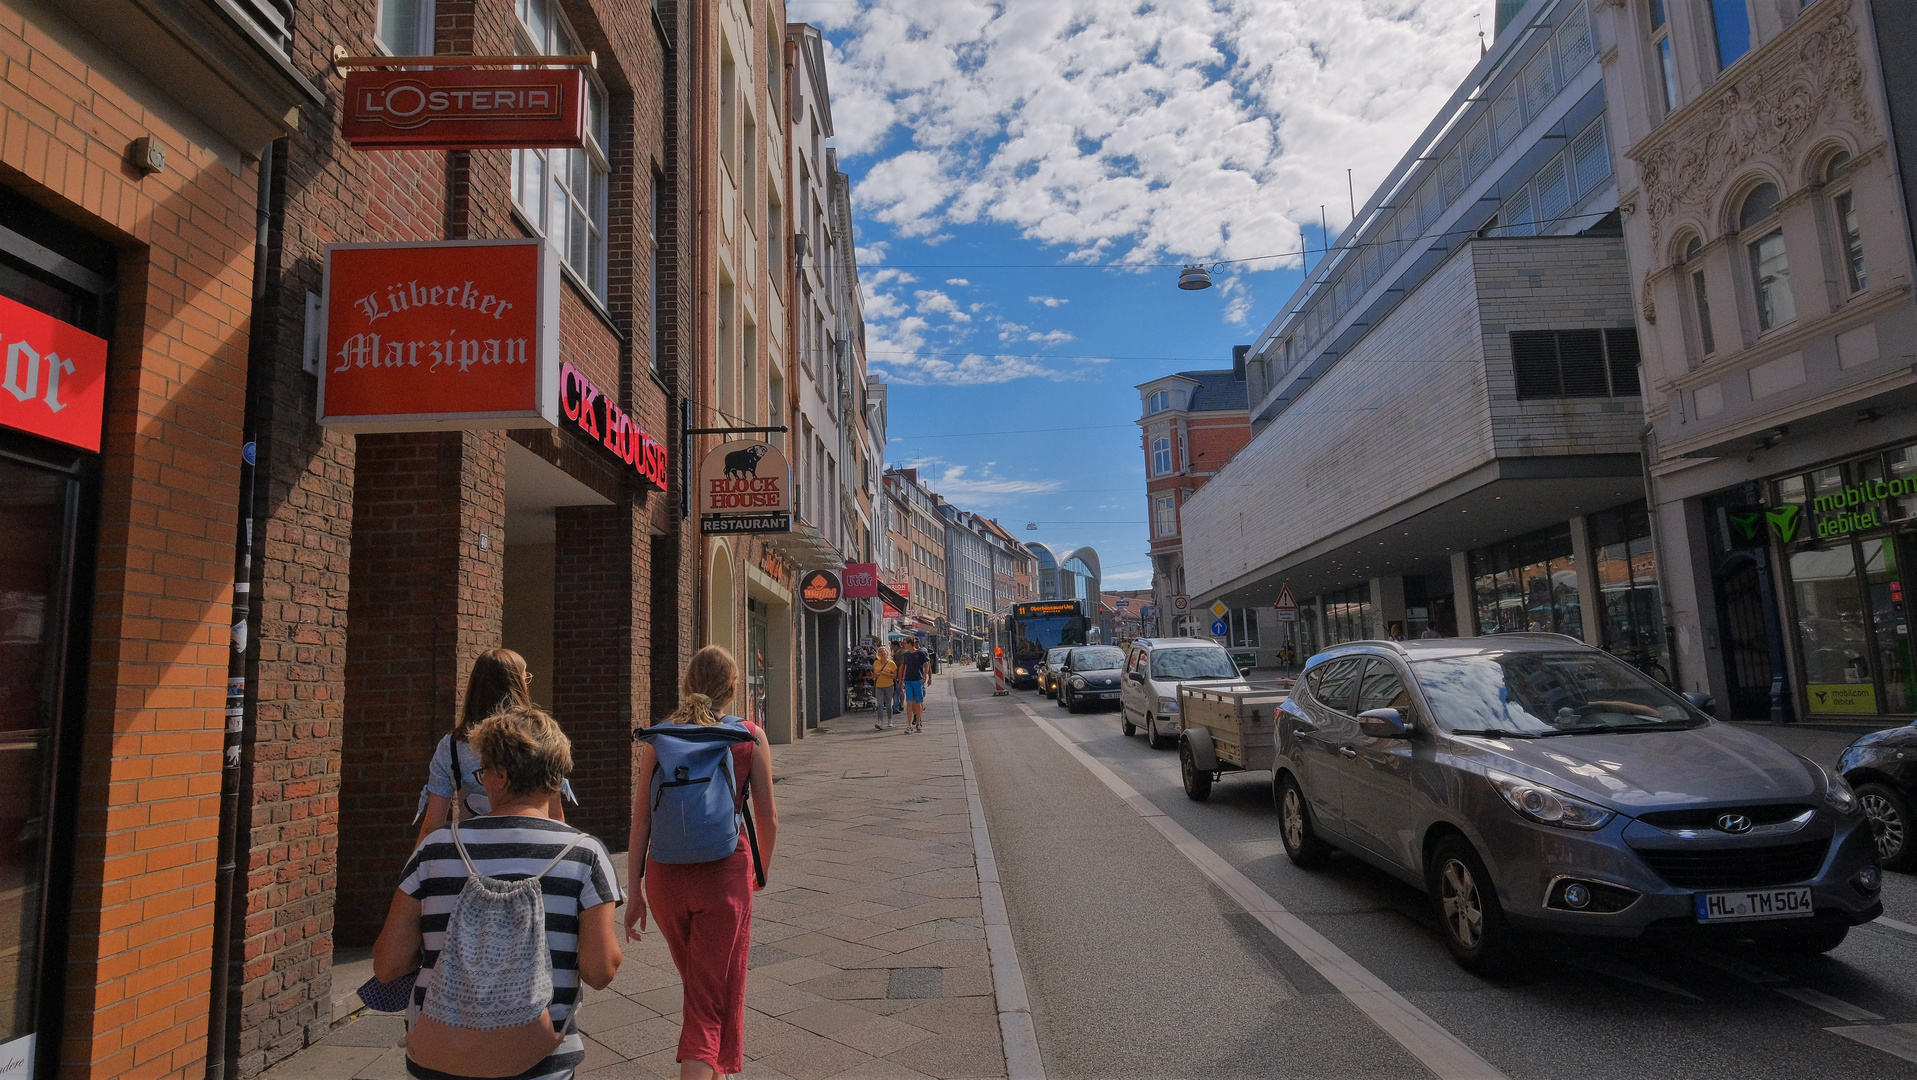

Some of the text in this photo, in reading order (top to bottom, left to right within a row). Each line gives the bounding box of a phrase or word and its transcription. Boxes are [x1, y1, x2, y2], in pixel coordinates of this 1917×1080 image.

[354, 279, 513, 326] Lübecker
[334, 329, 529, 374] Marzipan
[0, 337, 76, 413] or
[559, 361, 668, 491] CK HOUSE
[710, 477, 780, 493] BLOCK
[710, 492, 780, 509] HOUSE
[703, 518, 787, 531] RESTAURANT
[1817, 507, 1880, 537] debitel
[1019, 607, 1026, 615] 11
[1708, 895, 1735, 915] HL
